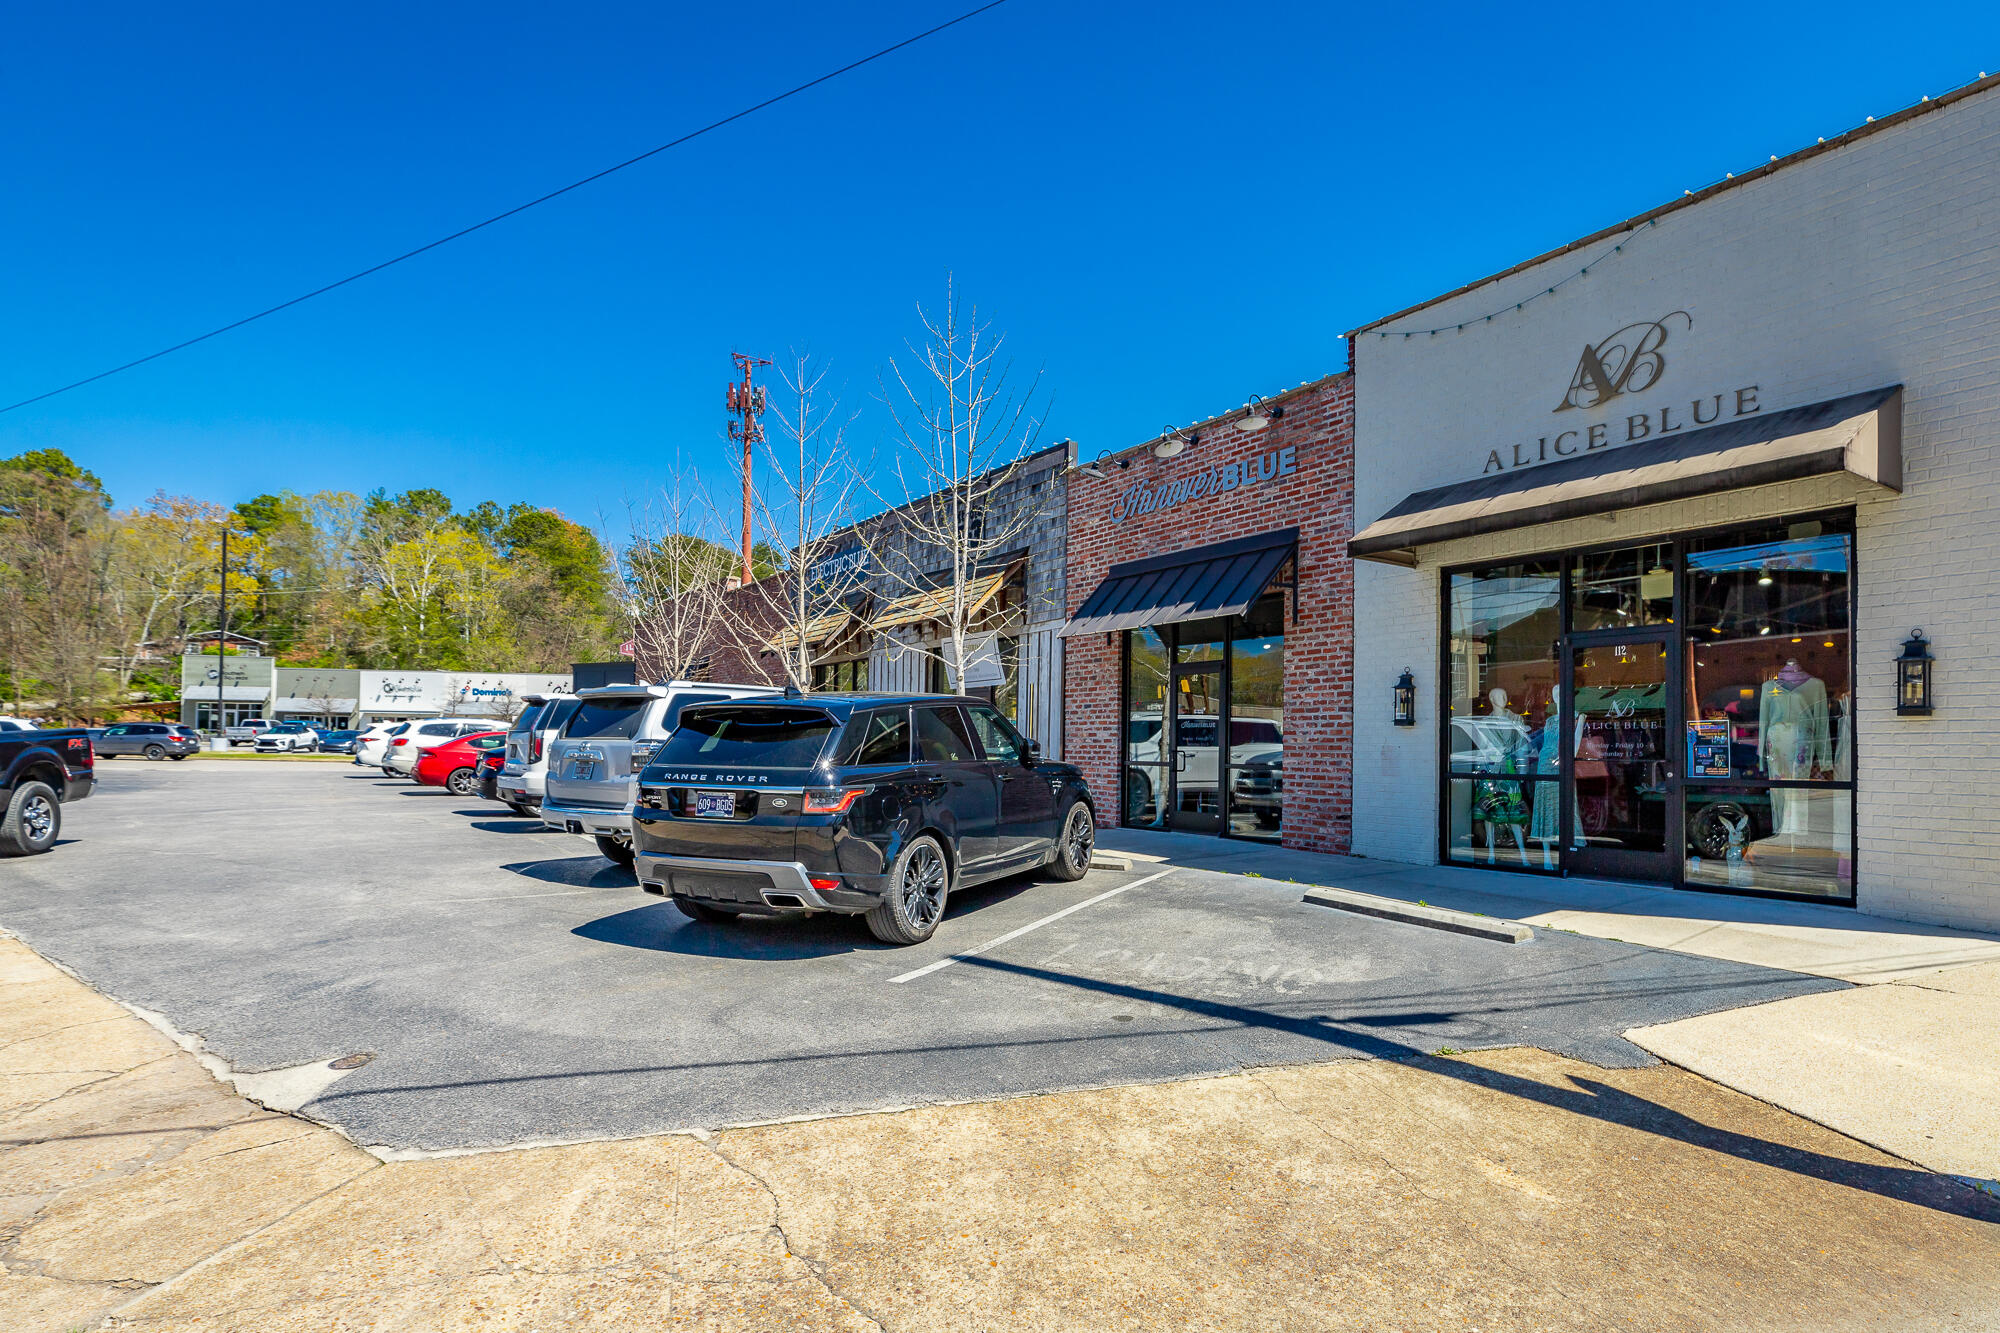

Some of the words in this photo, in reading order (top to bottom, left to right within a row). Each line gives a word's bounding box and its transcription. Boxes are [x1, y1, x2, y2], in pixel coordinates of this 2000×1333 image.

[1552, 310, 1692, 413] AB
[1483, 423, 1608, 474] ALICE
[1626, 385, 1761, 441] BLUE
[811, 554, 848, 581] ELECTRIC
[848, 549, 869, 568] BLUE
[1615, 645, 1627, 656] 112
[472, 687, 512, 696] Domino's
[1584, 721, 1621, 730] ALICE
[1624, 721, 1658, 730] BLUE
[664, 773, 707, 781] RANGE
[715, 774, 768, 782] ROVER
[698, 798, 711, 810] 609
